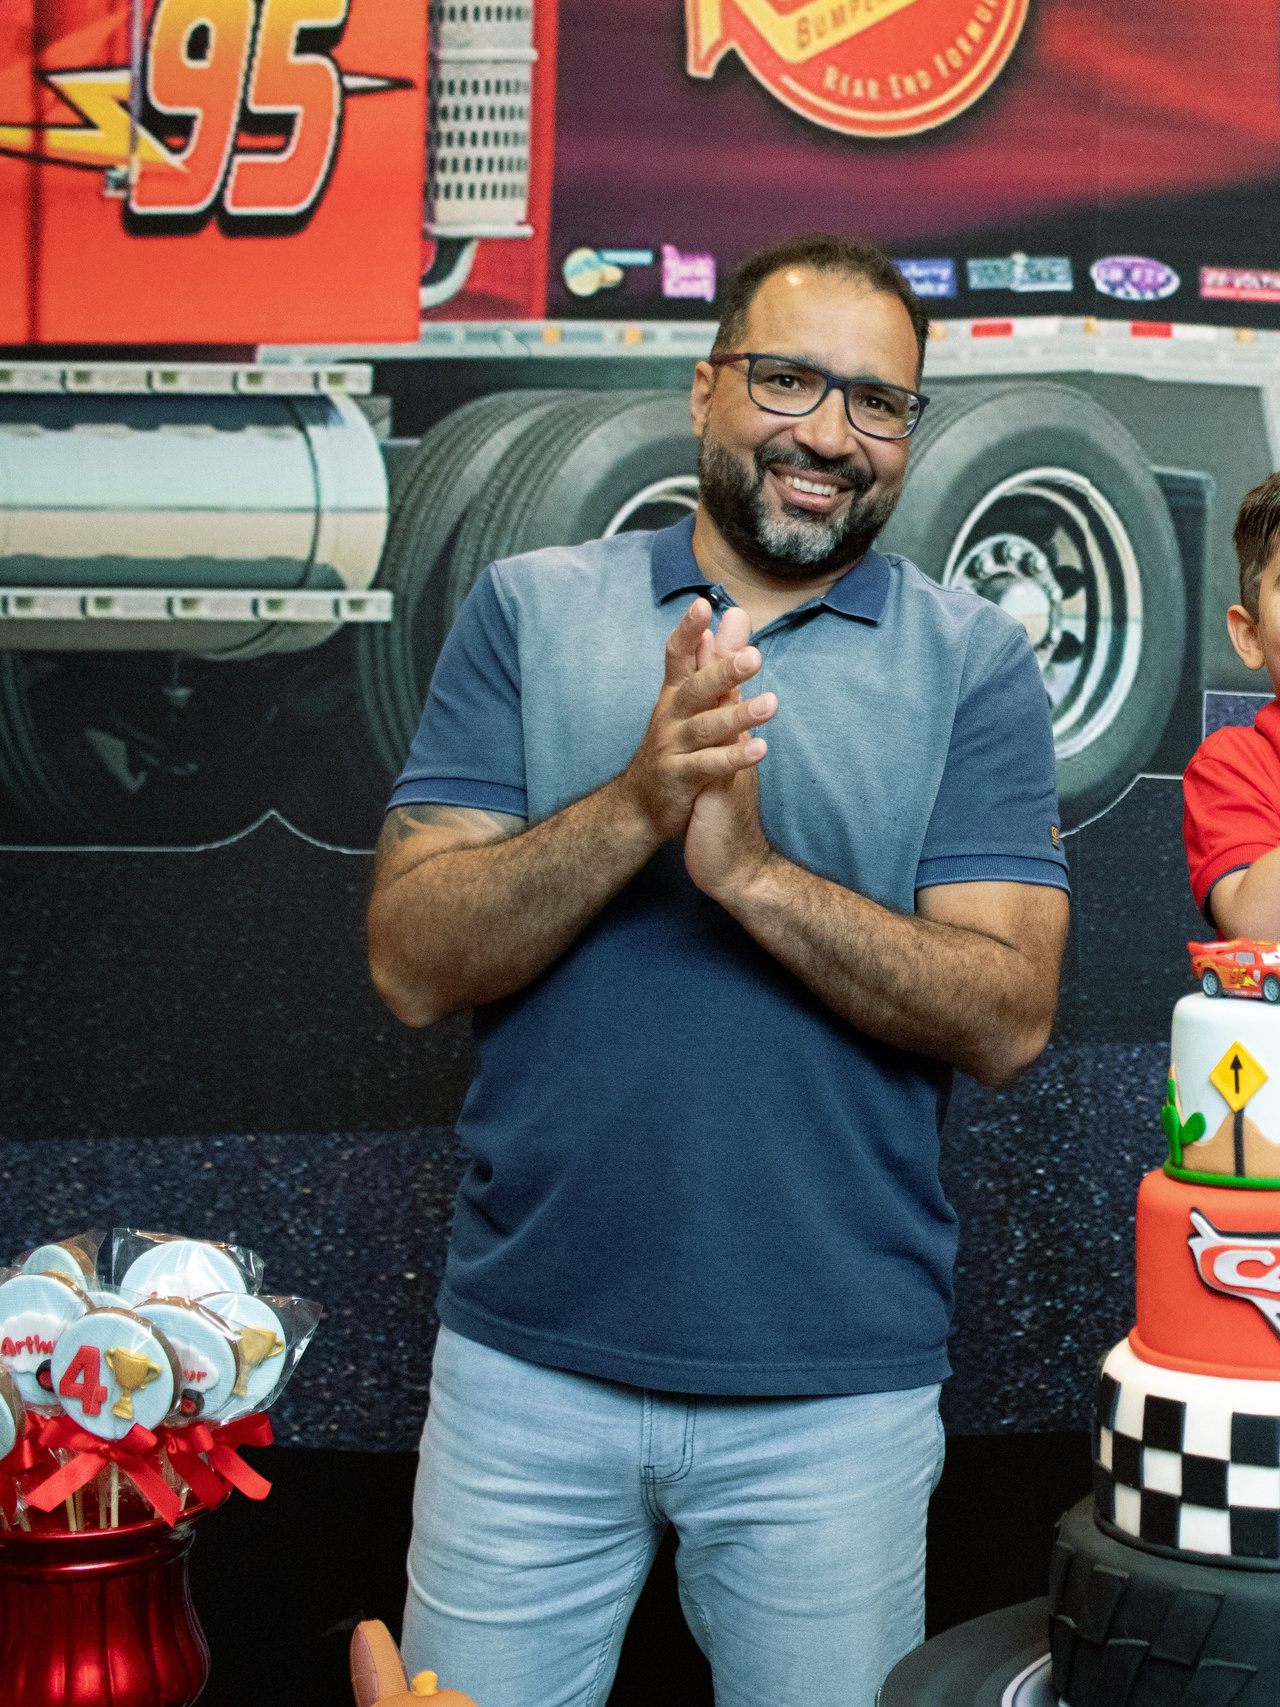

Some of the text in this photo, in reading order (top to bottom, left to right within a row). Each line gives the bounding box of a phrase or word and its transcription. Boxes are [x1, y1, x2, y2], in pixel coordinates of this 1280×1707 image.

[129, 0, 346, 216] 95
[823, 64, 880, 100] REAR
[888, 68, 931, 99] END
[1, 1333, 58, 1358] Arthu
[58, 1344, 108, 1416] 4
